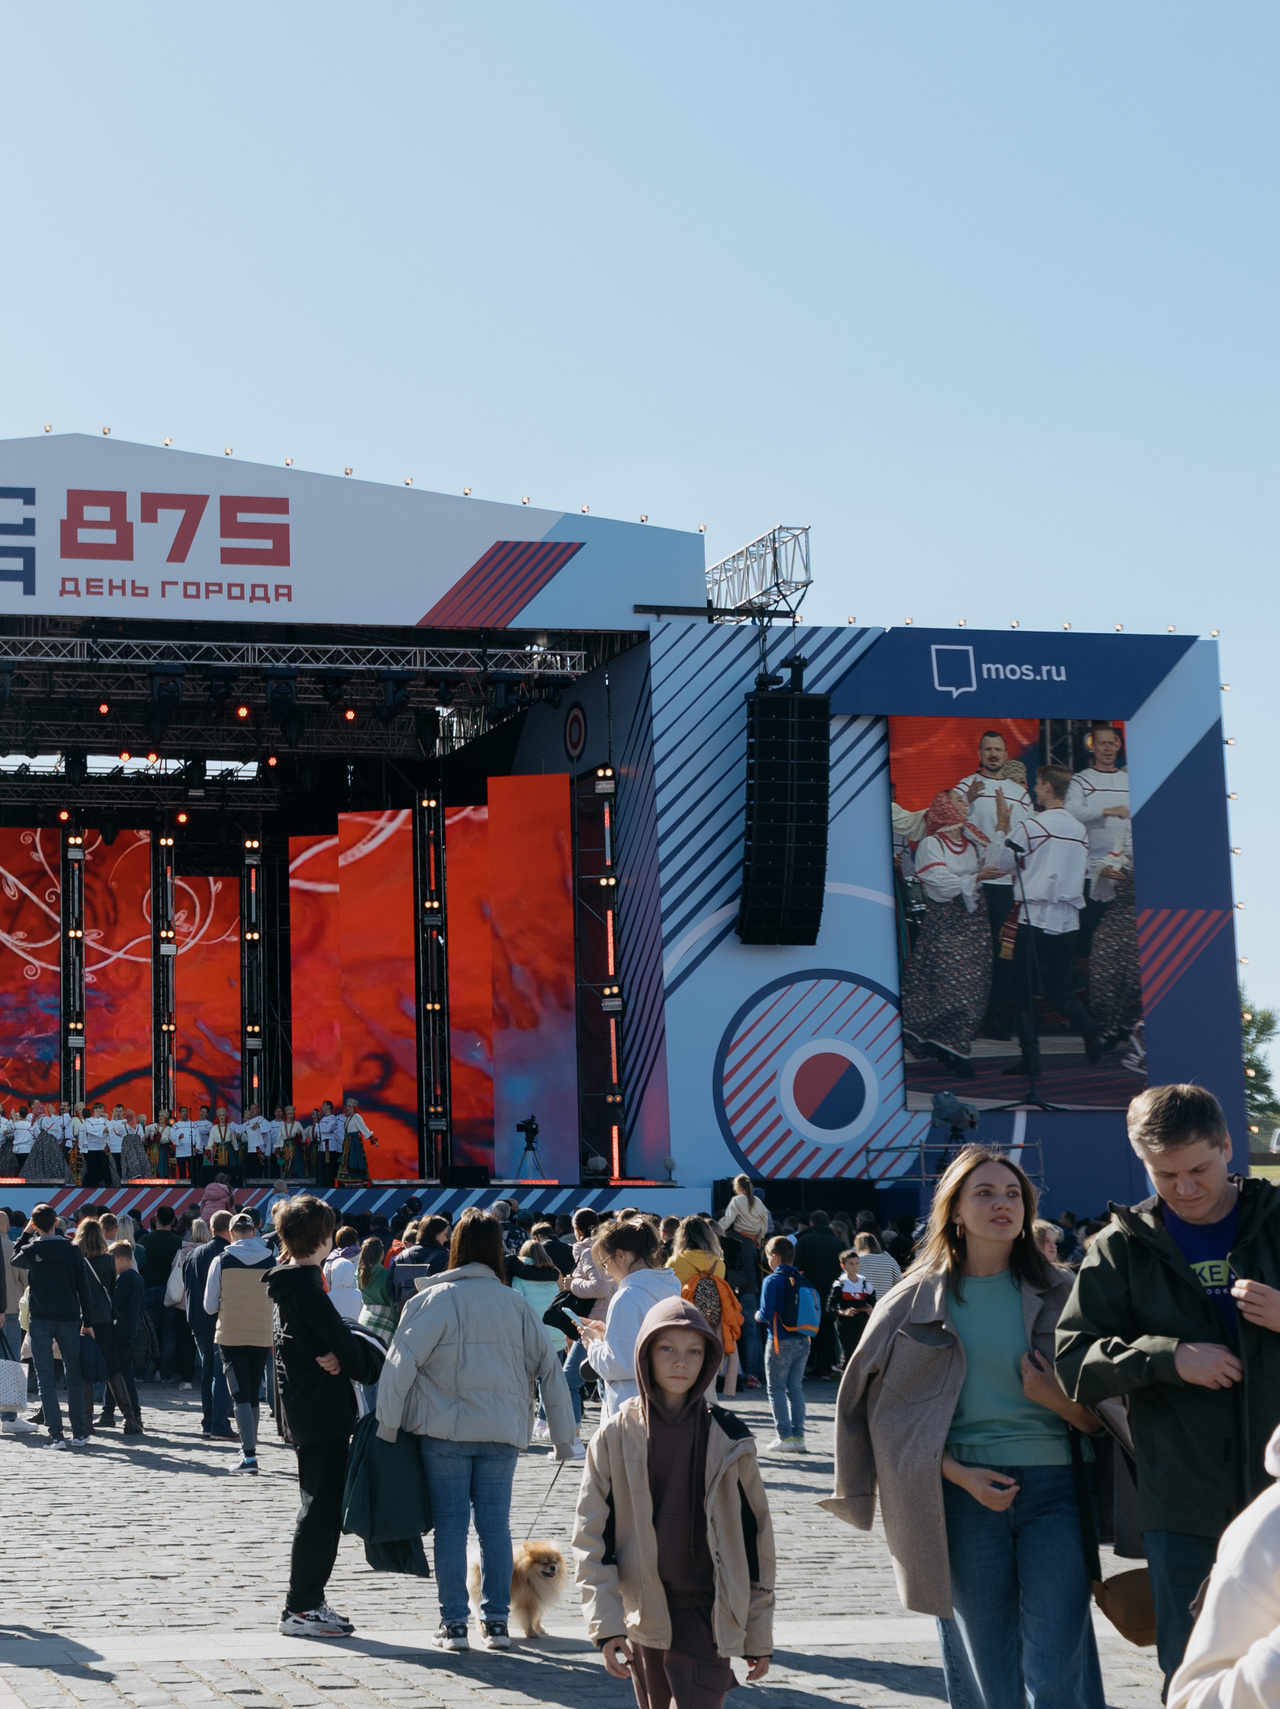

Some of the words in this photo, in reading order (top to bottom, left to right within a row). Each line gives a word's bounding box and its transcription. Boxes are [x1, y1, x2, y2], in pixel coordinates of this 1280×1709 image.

[60, 488, 291, 567] 875
[59, 577, 149, 598] ДЕНЬ
[161, 580, 293, 604] ГОРОДА
[981, 663, 1067, 681] mos.ru
